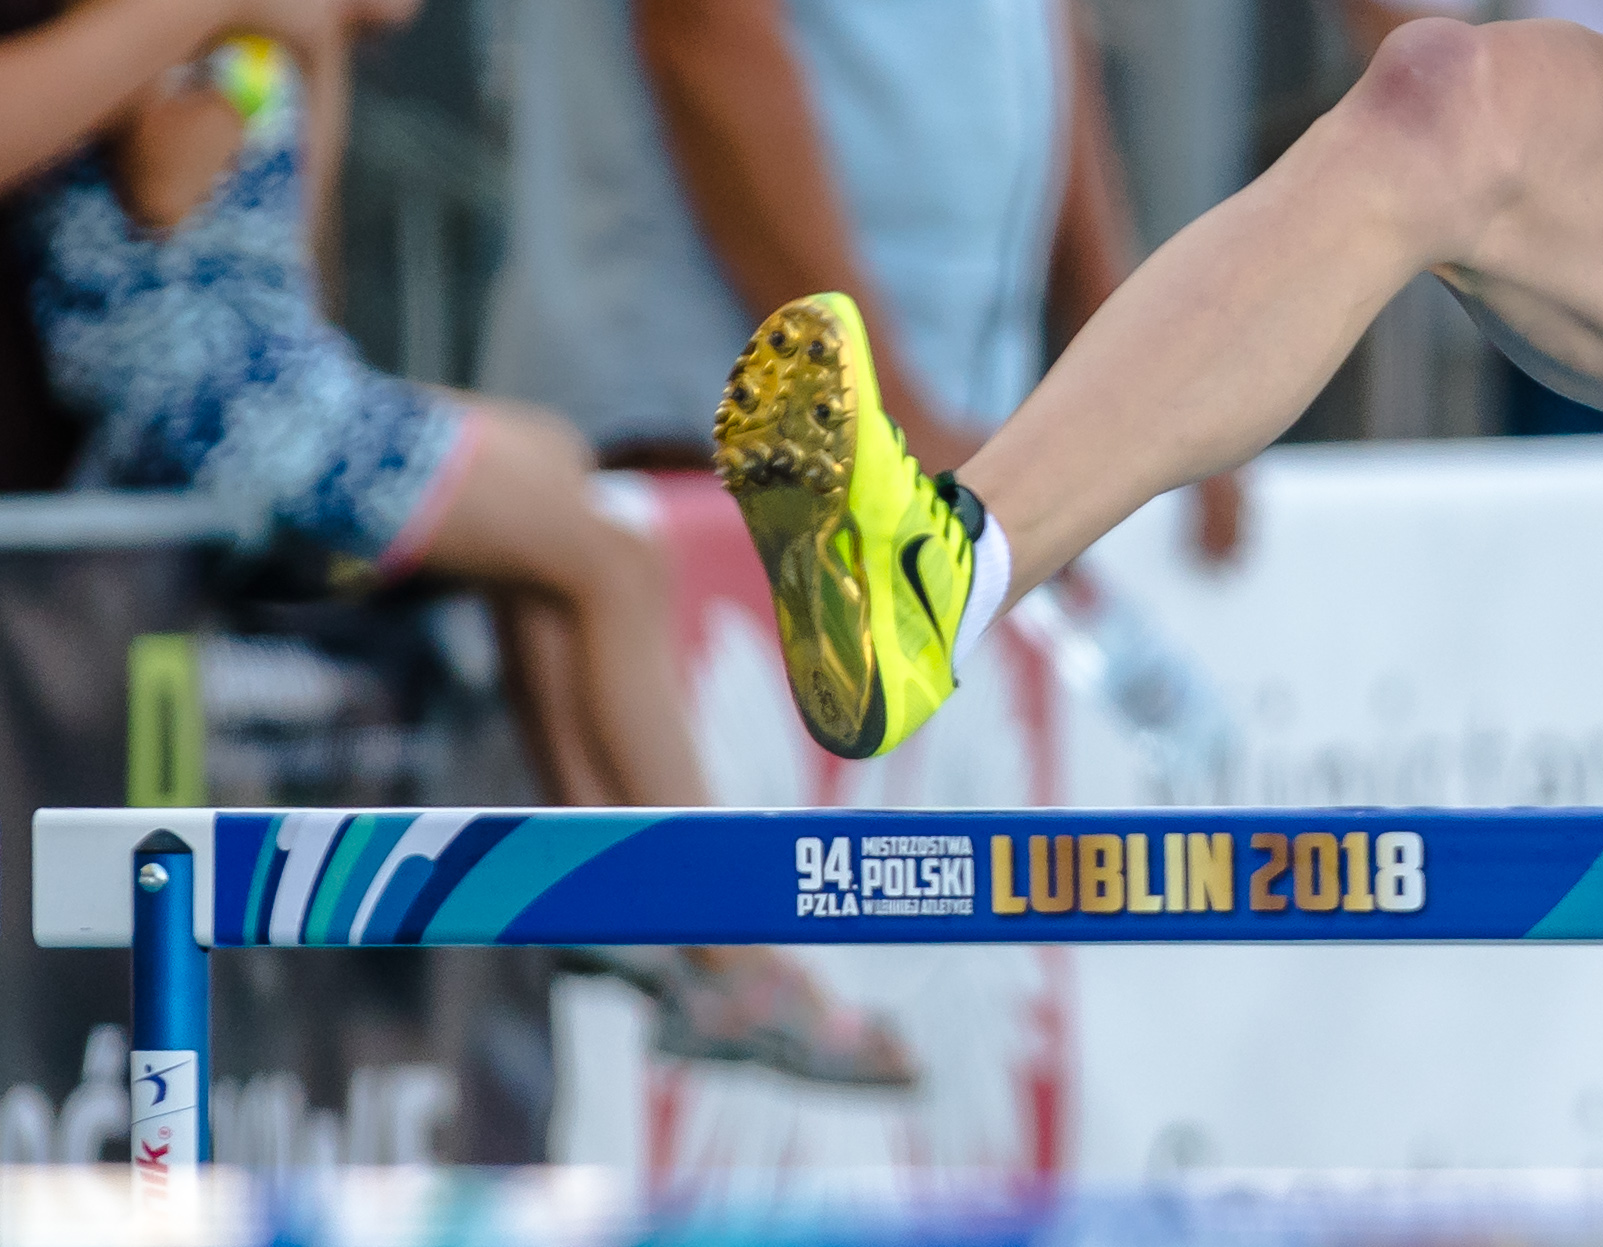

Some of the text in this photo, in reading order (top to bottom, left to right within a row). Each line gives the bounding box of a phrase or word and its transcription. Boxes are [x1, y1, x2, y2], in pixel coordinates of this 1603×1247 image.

[795, 836, 859, 892] 94.
[861, 835, 974, 857] MISTRZOSTWA
[861, 857, 976, 898] POLSKI
[990, 831, 1426, 914] LUBLIN 2018
[796, 892, 860, 918] PZLA
